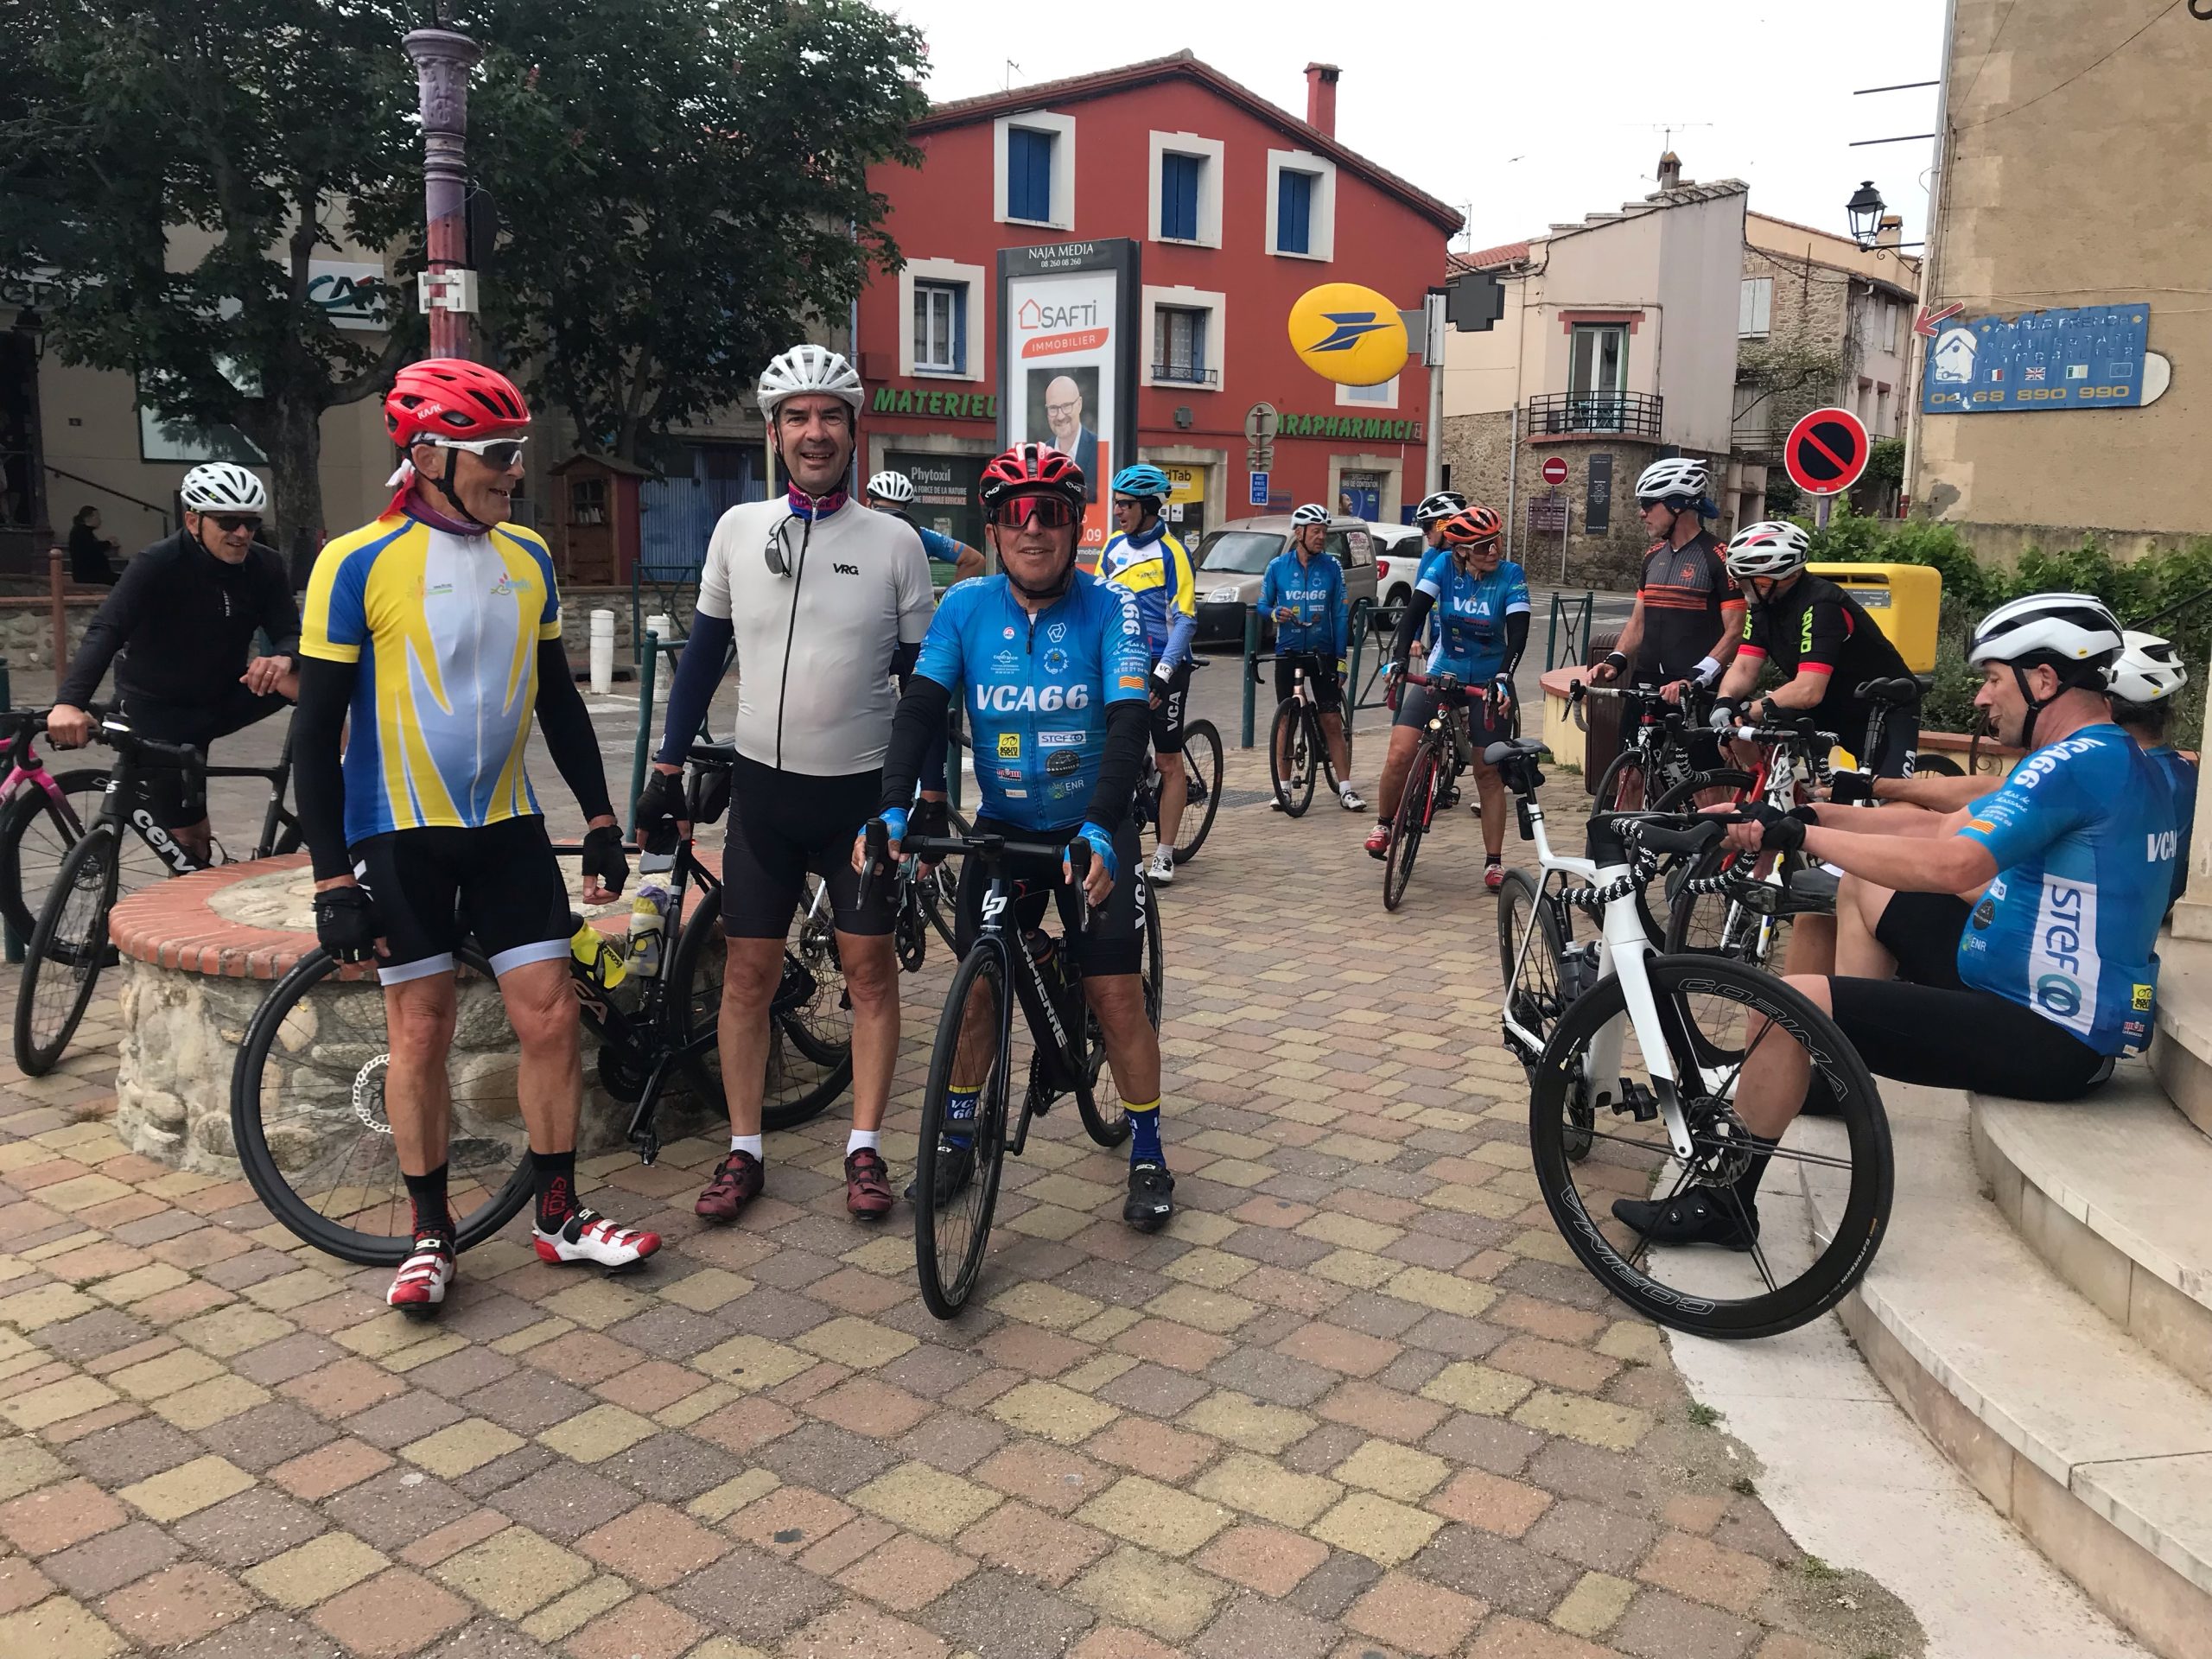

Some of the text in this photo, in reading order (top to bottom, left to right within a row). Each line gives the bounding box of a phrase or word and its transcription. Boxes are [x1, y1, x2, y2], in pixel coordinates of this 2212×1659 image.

[1028, 243, 1094, 260] NAJA MEDIA
[1032, 334, 1096, 353] IMMOBILIER
[873, 387, 996, 418] MATERIEL
[1931, 385, 2130, 404] 04 68 890 990
[911, 467, 950, 484] Phytoxil
[1092, 576, 1141, 636] VCA66
[1285, 589, 1327, 601] VCA66
[1453, 595, 1491, 616] VCA
[976, 683, 1090, 713] VCA66
[1166, 691, 1181, 733] VCA
[2013, 737, 2107, 789] VCA66
[1065, 779, 1085, 791] ENR
[132, 809, 198, 873] cerv
[1135, 861, 1146, 930] VCA
[1971, 937, 1987, 952] ENR
[1678, 977, 1849, 1103] CORIMA
[1560, 1185, 1716, 1316] CORIMA
